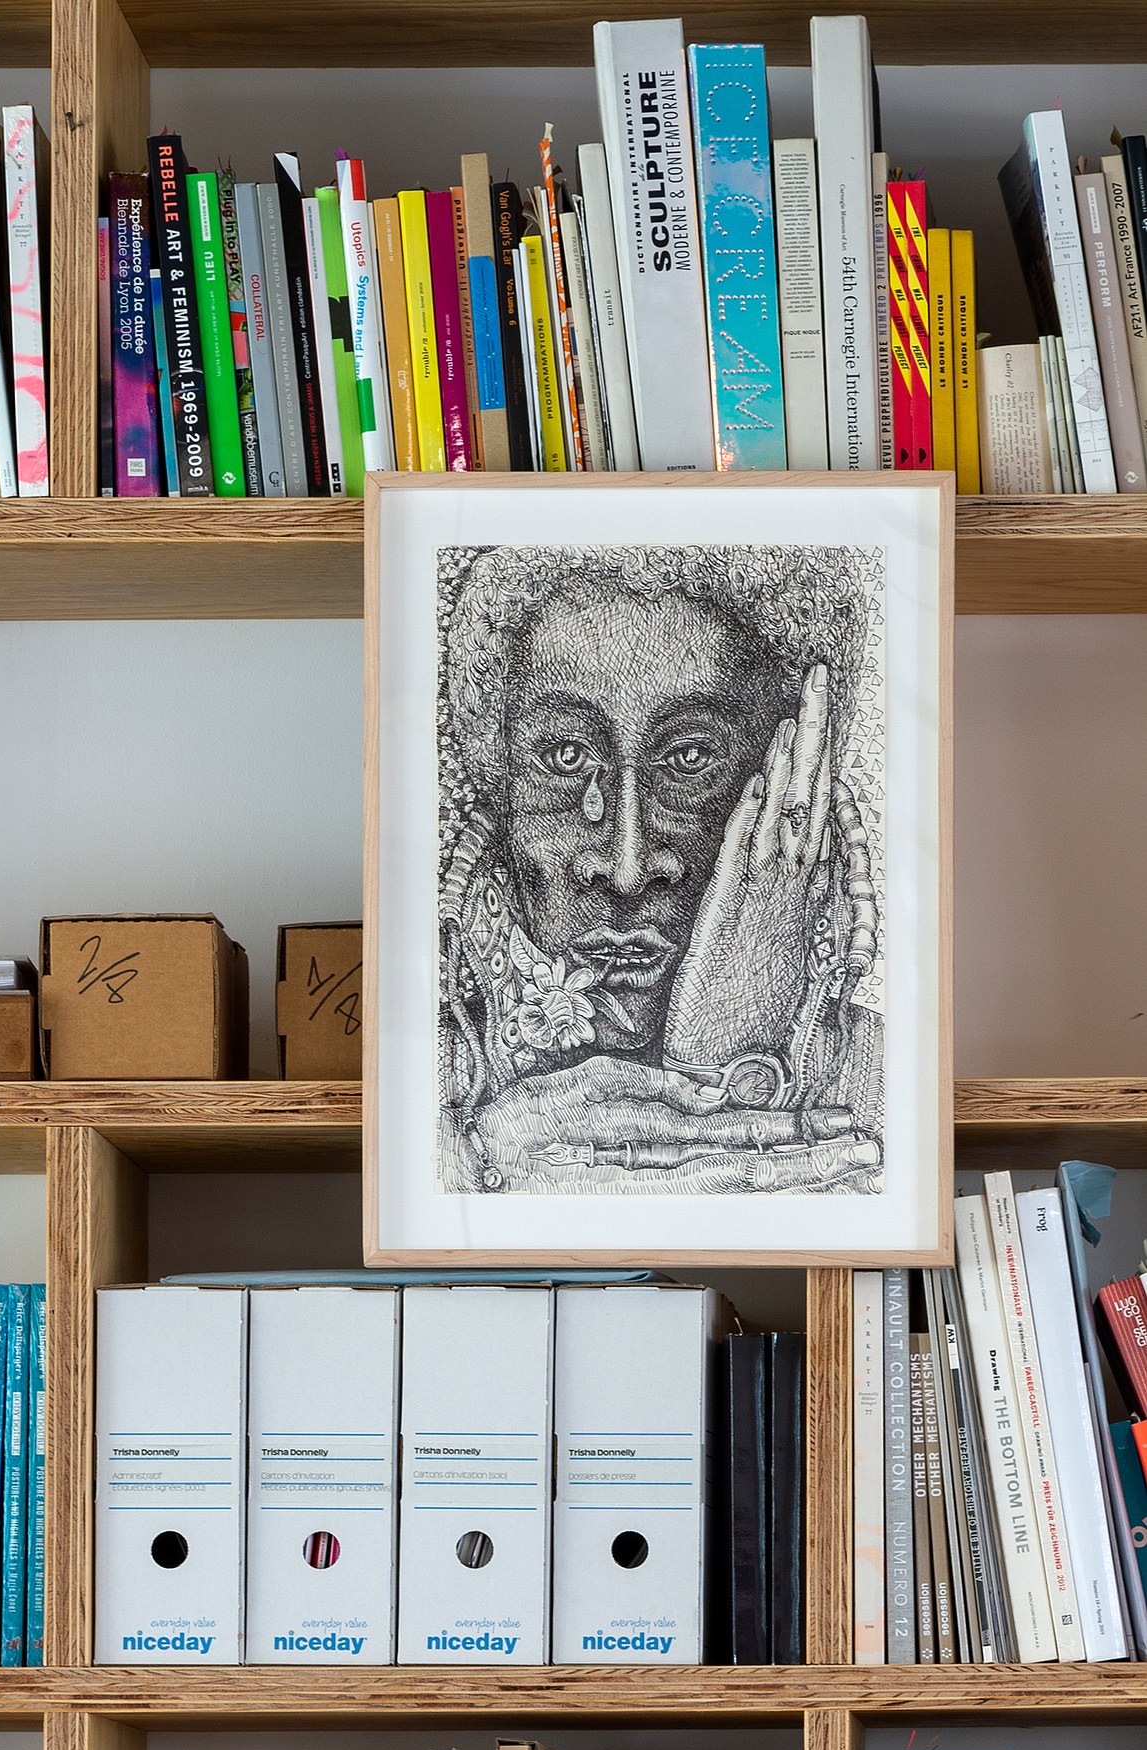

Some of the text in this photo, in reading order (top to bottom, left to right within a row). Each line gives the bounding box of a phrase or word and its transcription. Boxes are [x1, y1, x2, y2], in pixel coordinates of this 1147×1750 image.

[158, 145, 180, 223] REBELLE
[623, 73, 645, 274] DICTIONNAIRE INTERNATIONAL
[638, 71, 672, 272] SCULPTURE
[659, 70, 691, 271] MODERNE & CONTEMPORAINE
[166, 229, 183, 263] ART
[351, 221, 366, 267] Utopics
[117, 199, 133, 350] Biennale de Lyon 2005
[131, 199, 148, 354] Expérience de la durée
[171, 269, 184, 281] &
[1094, 242, 1111, 307] PERFORM
[250, 274, 266, 342] COLLATERAL
[712, 195, 775, 430] CREAM
[180, 380, 203, 478] 1969-2009
[1036, 1207, 1048, 1233] Frog
[113, 1448, 180, 1457] Trisha Donnelly
[261, 1448, 329, 1457] Trisha Donnelly
[414, 1447, 481, 1456] Trisha Donnelly
[568, 1448, 636, 1457] Trisha Donnelly
[890, 1362, 905, 1491] COLLECTION
[910, 1353, 926, 1498] OTHER MECHANISMS
[989, 1349, 1030, 1554] Drawing THE BOTTOM LINE
[413, 1470, 443, 1479] Cartons
[122, 1630, 213, 1654] niceday
[274, 1630, 364, 1654] niceday
[427, 1630, 517, 1654] niceday
[582, 1630, 673, 1654] niceday
